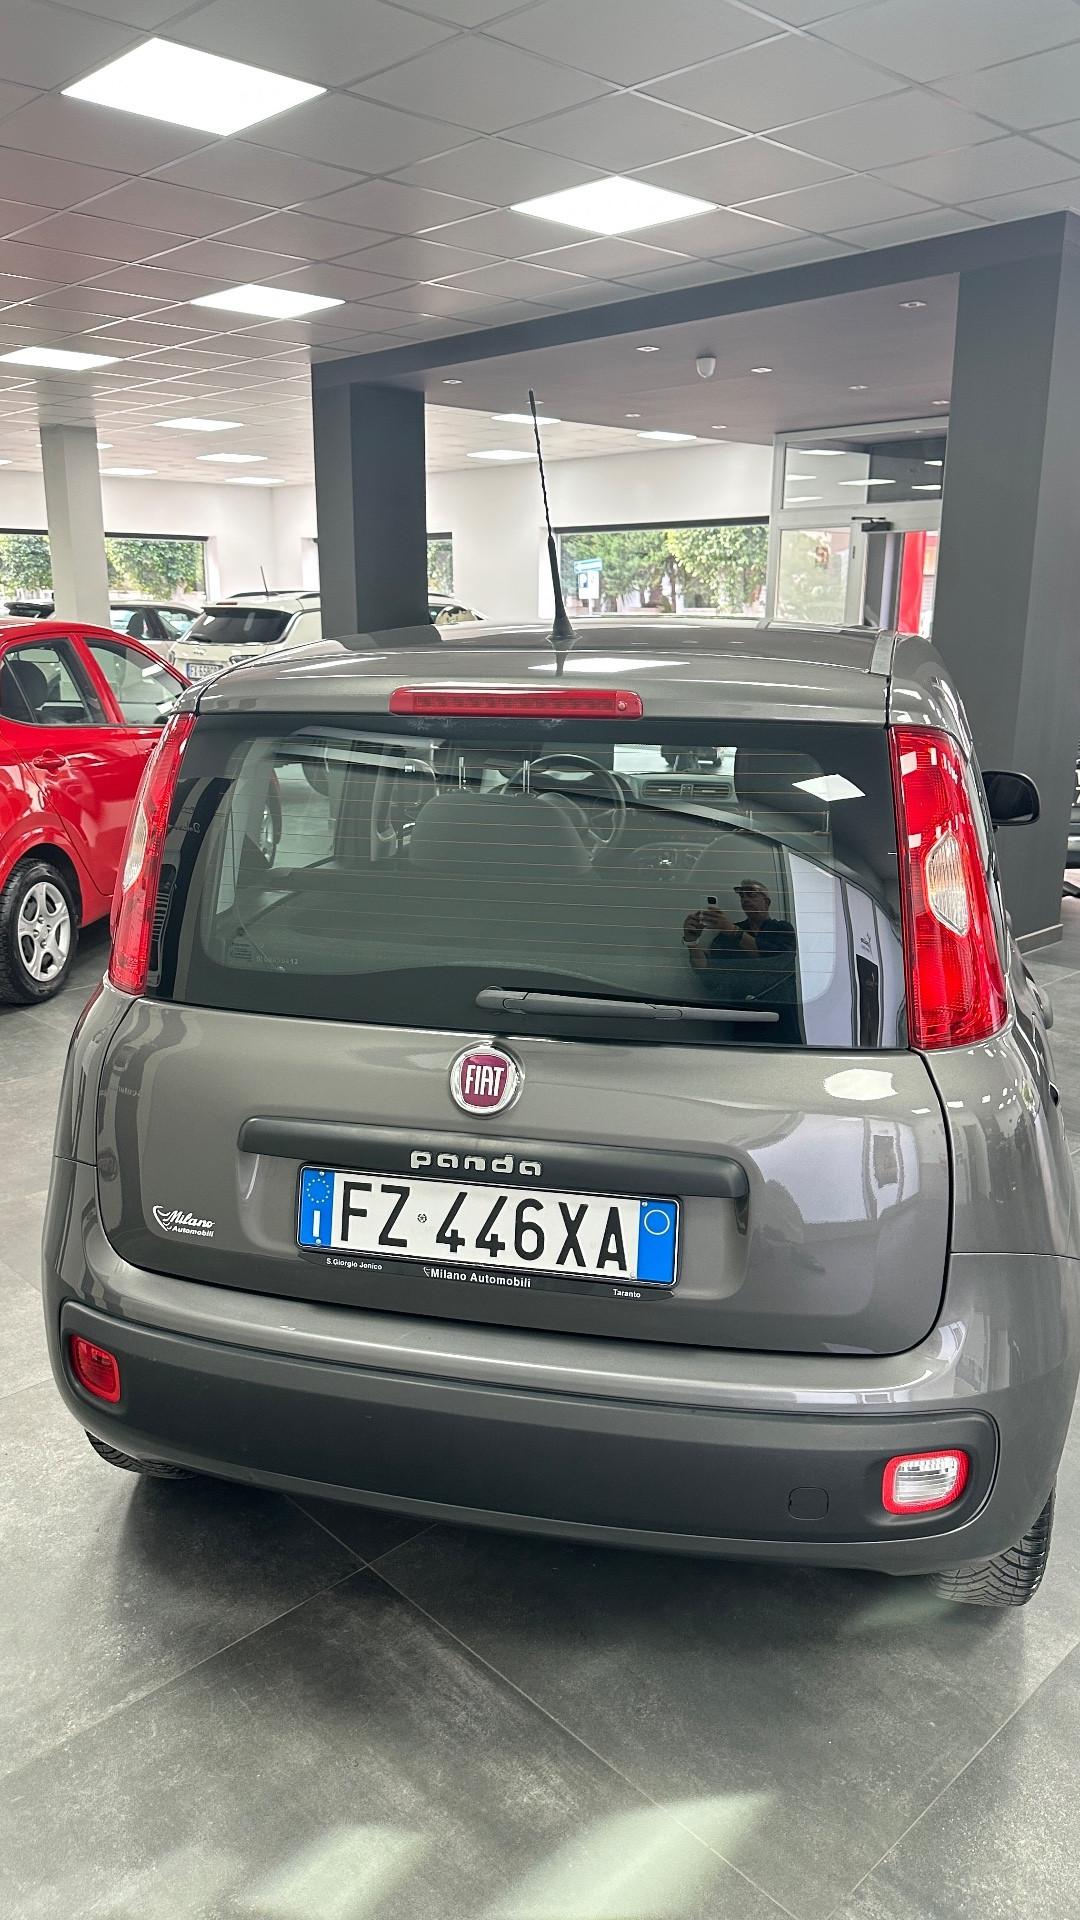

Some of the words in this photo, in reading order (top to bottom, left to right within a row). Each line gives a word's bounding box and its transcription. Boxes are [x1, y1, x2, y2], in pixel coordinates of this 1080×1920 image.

[465, 1064, 504, 1097] FIAT
[410, 1150, 542, 1176] panda
[162, 1210, 215, 1229] Milano
[341, 1180, 410, 1248] FZ
[436, 1191, 627, 1271] 446XA
[172, 1226, 215, 1237] Automobili
[359, 1261, 383, 1270] Jonico
[430, 1268, 467, 1281] Milano
[469, 1272, 531, 1288] Automobili
[613, 1288, 641, 1299] Taranto
